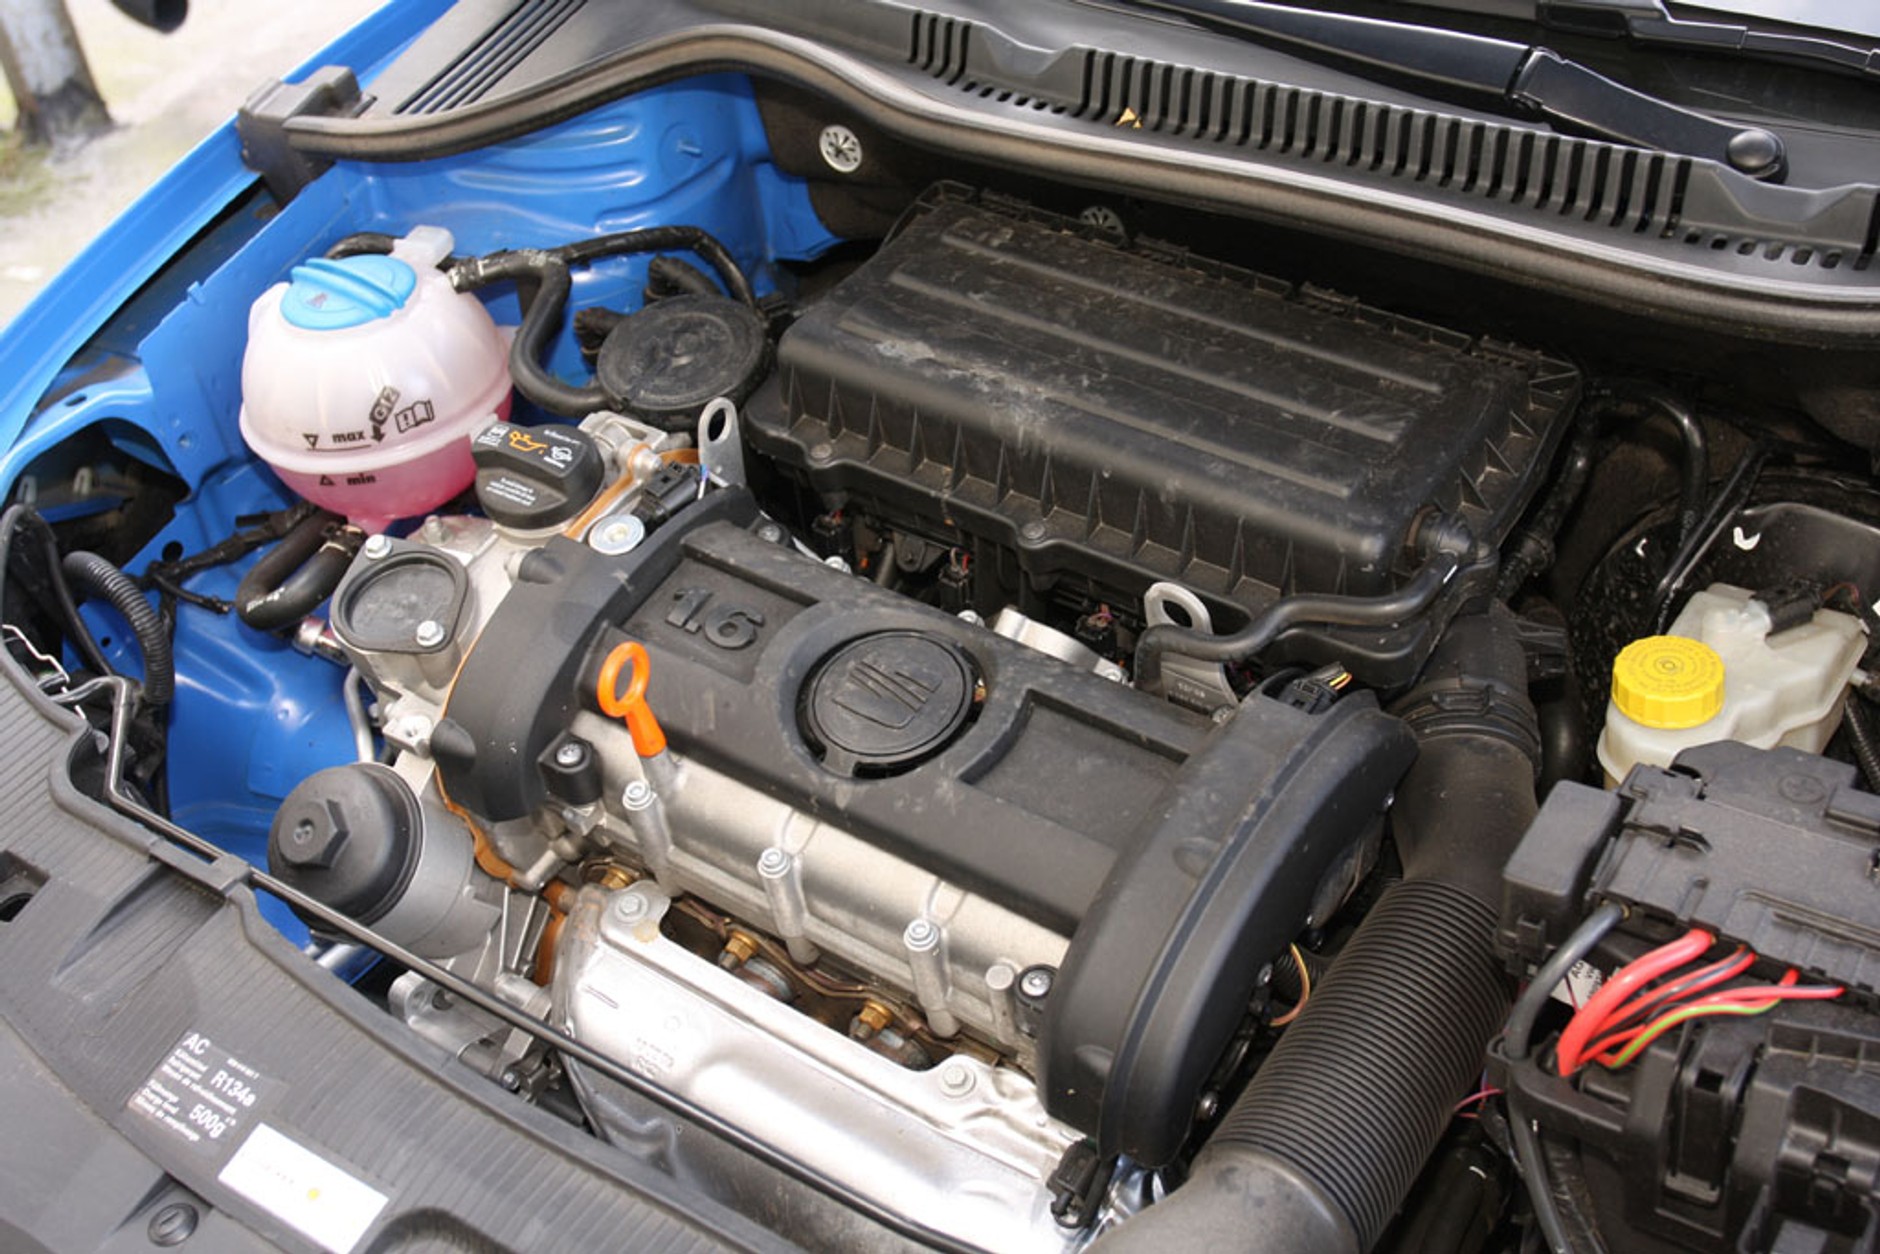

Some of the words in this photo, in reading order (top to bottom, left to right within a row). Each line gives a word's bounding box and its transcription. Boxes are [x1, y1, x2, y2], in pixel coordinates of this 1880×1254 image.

[332, 430, 366, 443] max
[346, 473, 377, 486] min
[182, 1033, 211, 1055] AC
[210, 1070, 256, 1107] R134a
[189, 1103, 226, 1138] 500g
